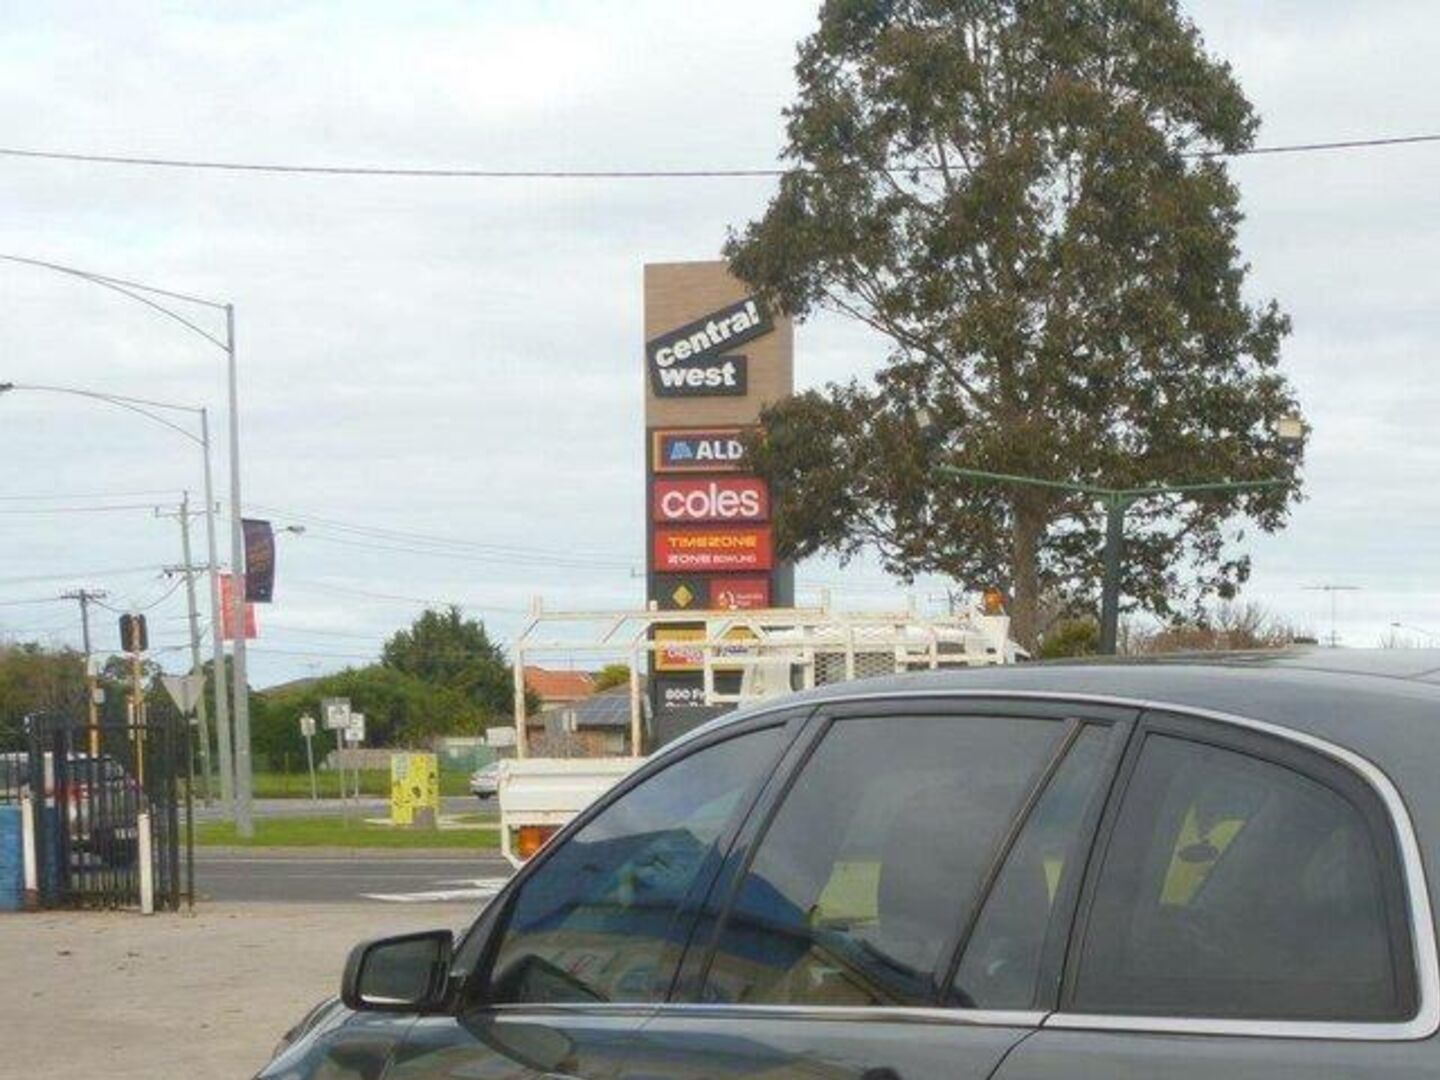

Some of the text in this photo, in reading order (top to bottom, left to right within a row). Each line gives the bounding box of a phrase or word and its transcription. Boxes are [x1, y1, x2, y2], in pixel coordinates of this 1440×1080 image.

[655, 301, 760, 367] central
[658, 361, 737, 387] west
[695, 439, 745, 460] ALD
[661, 483, 760, 518] coles
[668, 535, 757, 548] TIMEZONE
